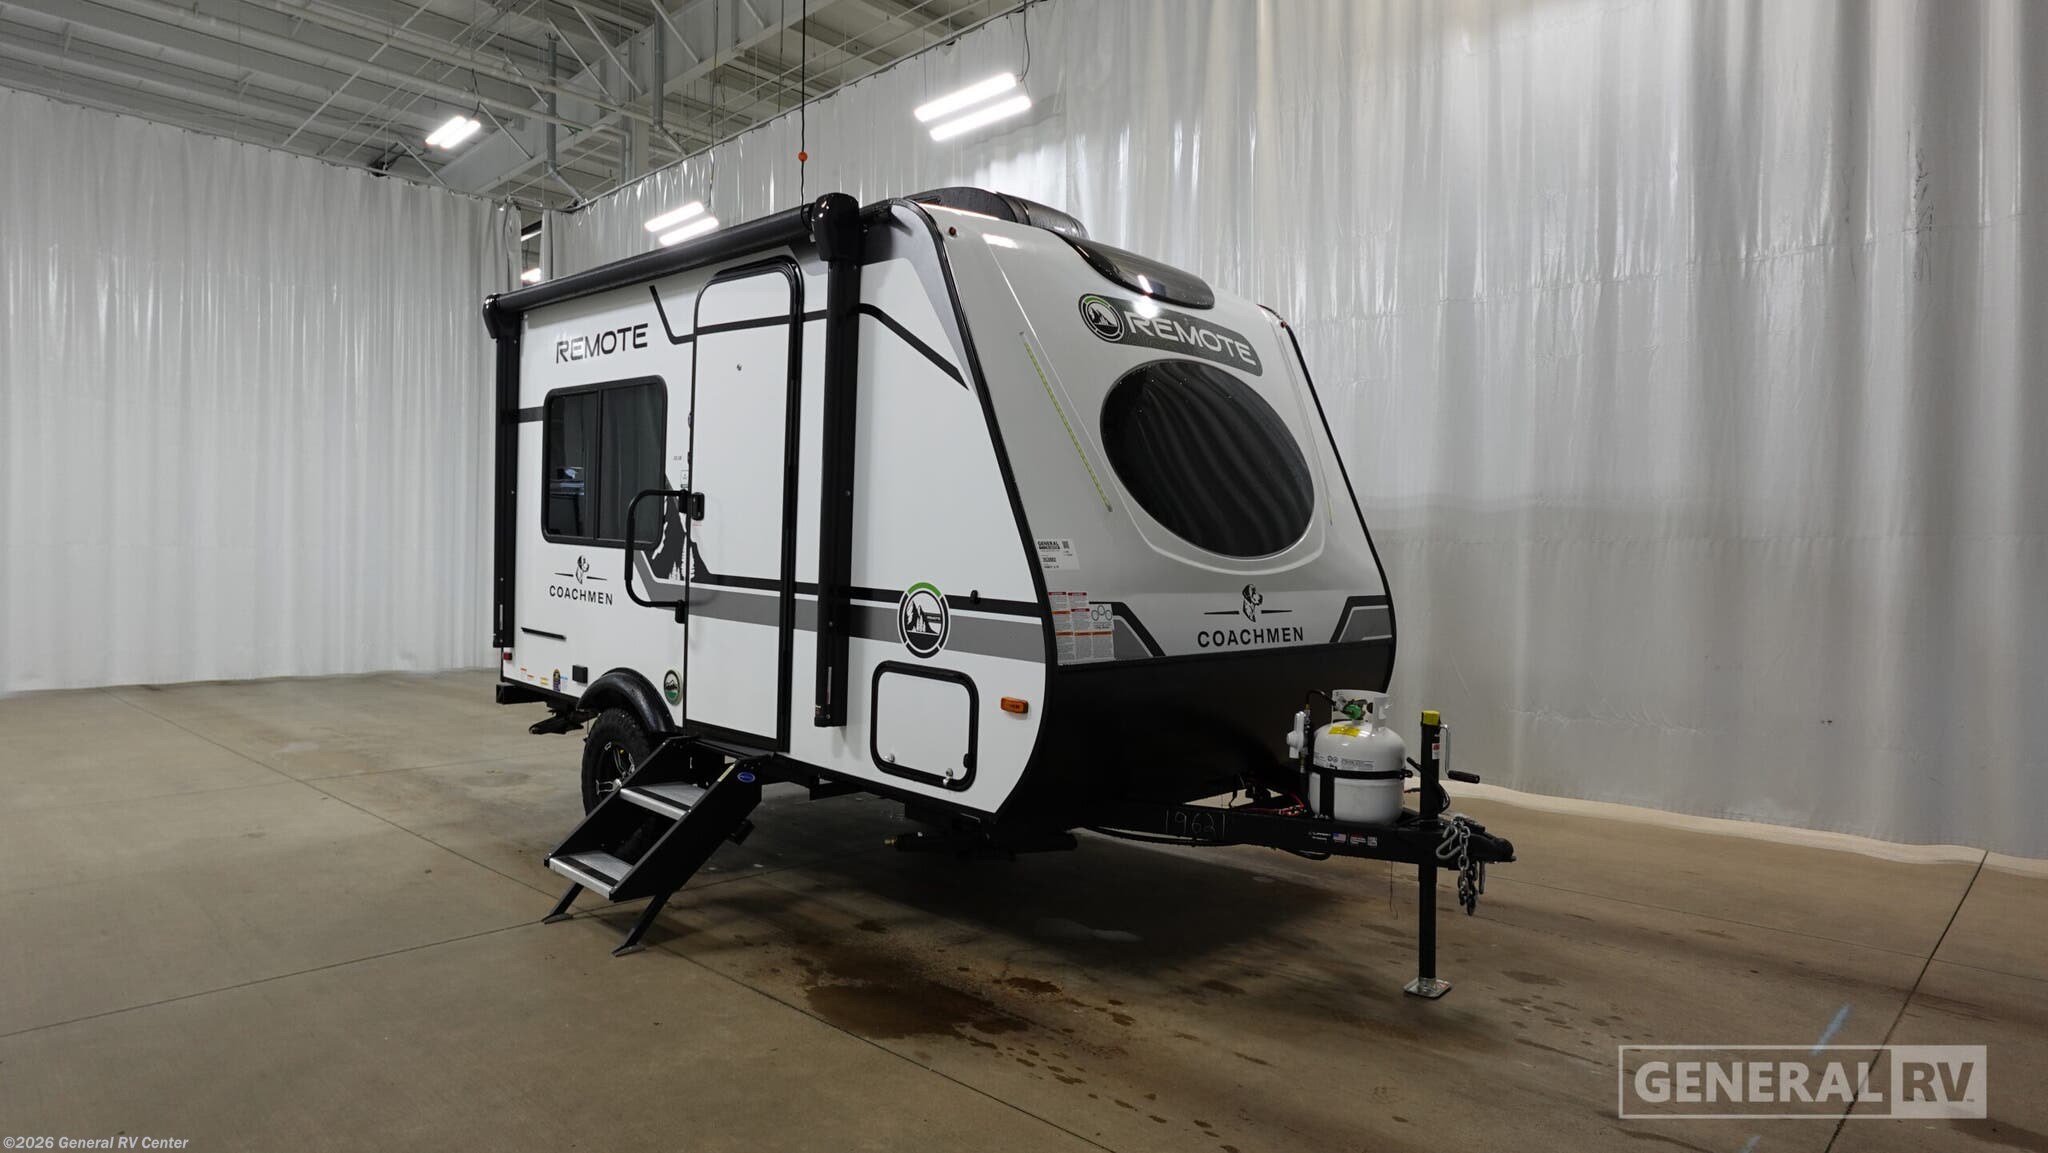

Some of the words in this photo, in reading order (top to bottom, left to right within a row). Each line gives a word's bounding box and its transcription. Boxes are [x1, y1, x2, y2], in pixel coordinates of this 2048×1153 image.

[556, 323, 648, 364] REMOTE
[1124, 311, 1257, 366] REMOTE
[548, 584, 614, 606] COACHMEN
[1197, 626, 1305, 649] COACHMEN
